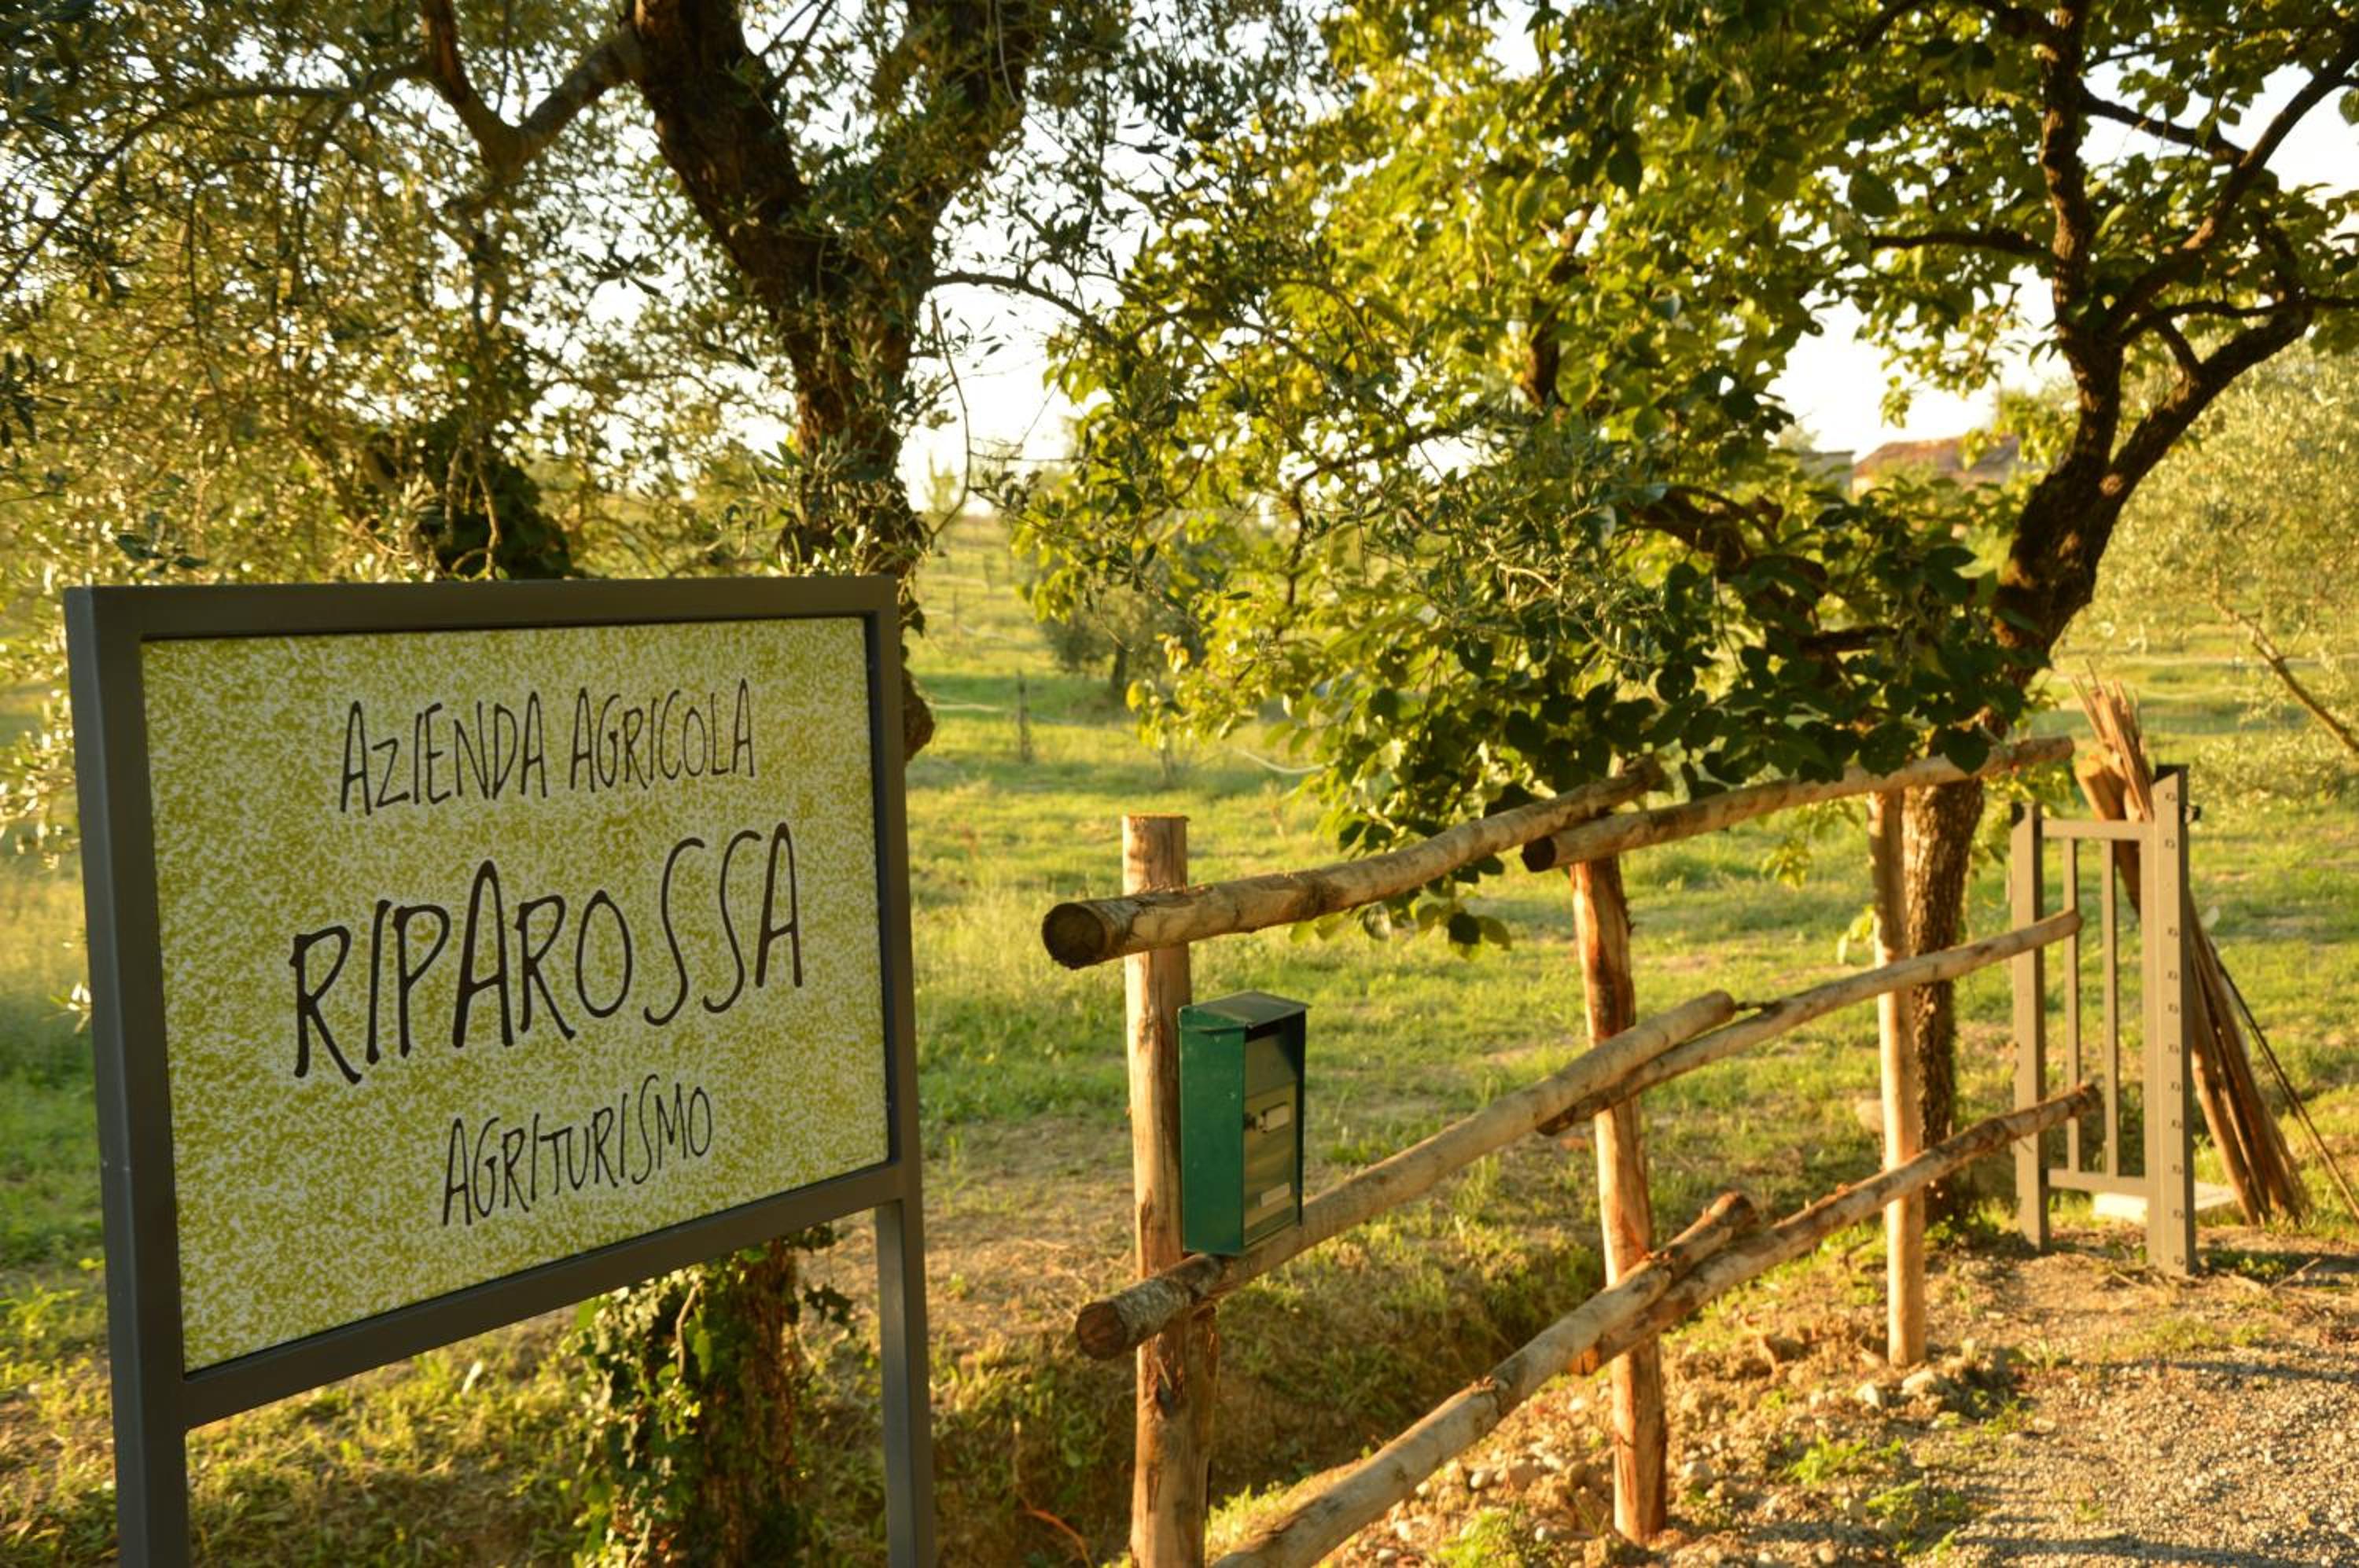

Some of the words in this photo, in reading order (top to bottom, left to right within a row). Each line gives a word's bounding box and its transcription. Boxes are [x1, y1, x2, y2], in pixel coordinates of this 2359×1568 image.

[340, 690, 550, 816] AZIENDA
[569, 678, 756, 794] AGRICOLA
[288, 822, 803, 1085] RIPAROSSA
[442, 1073, 712, 1227] AGRITURISMO
